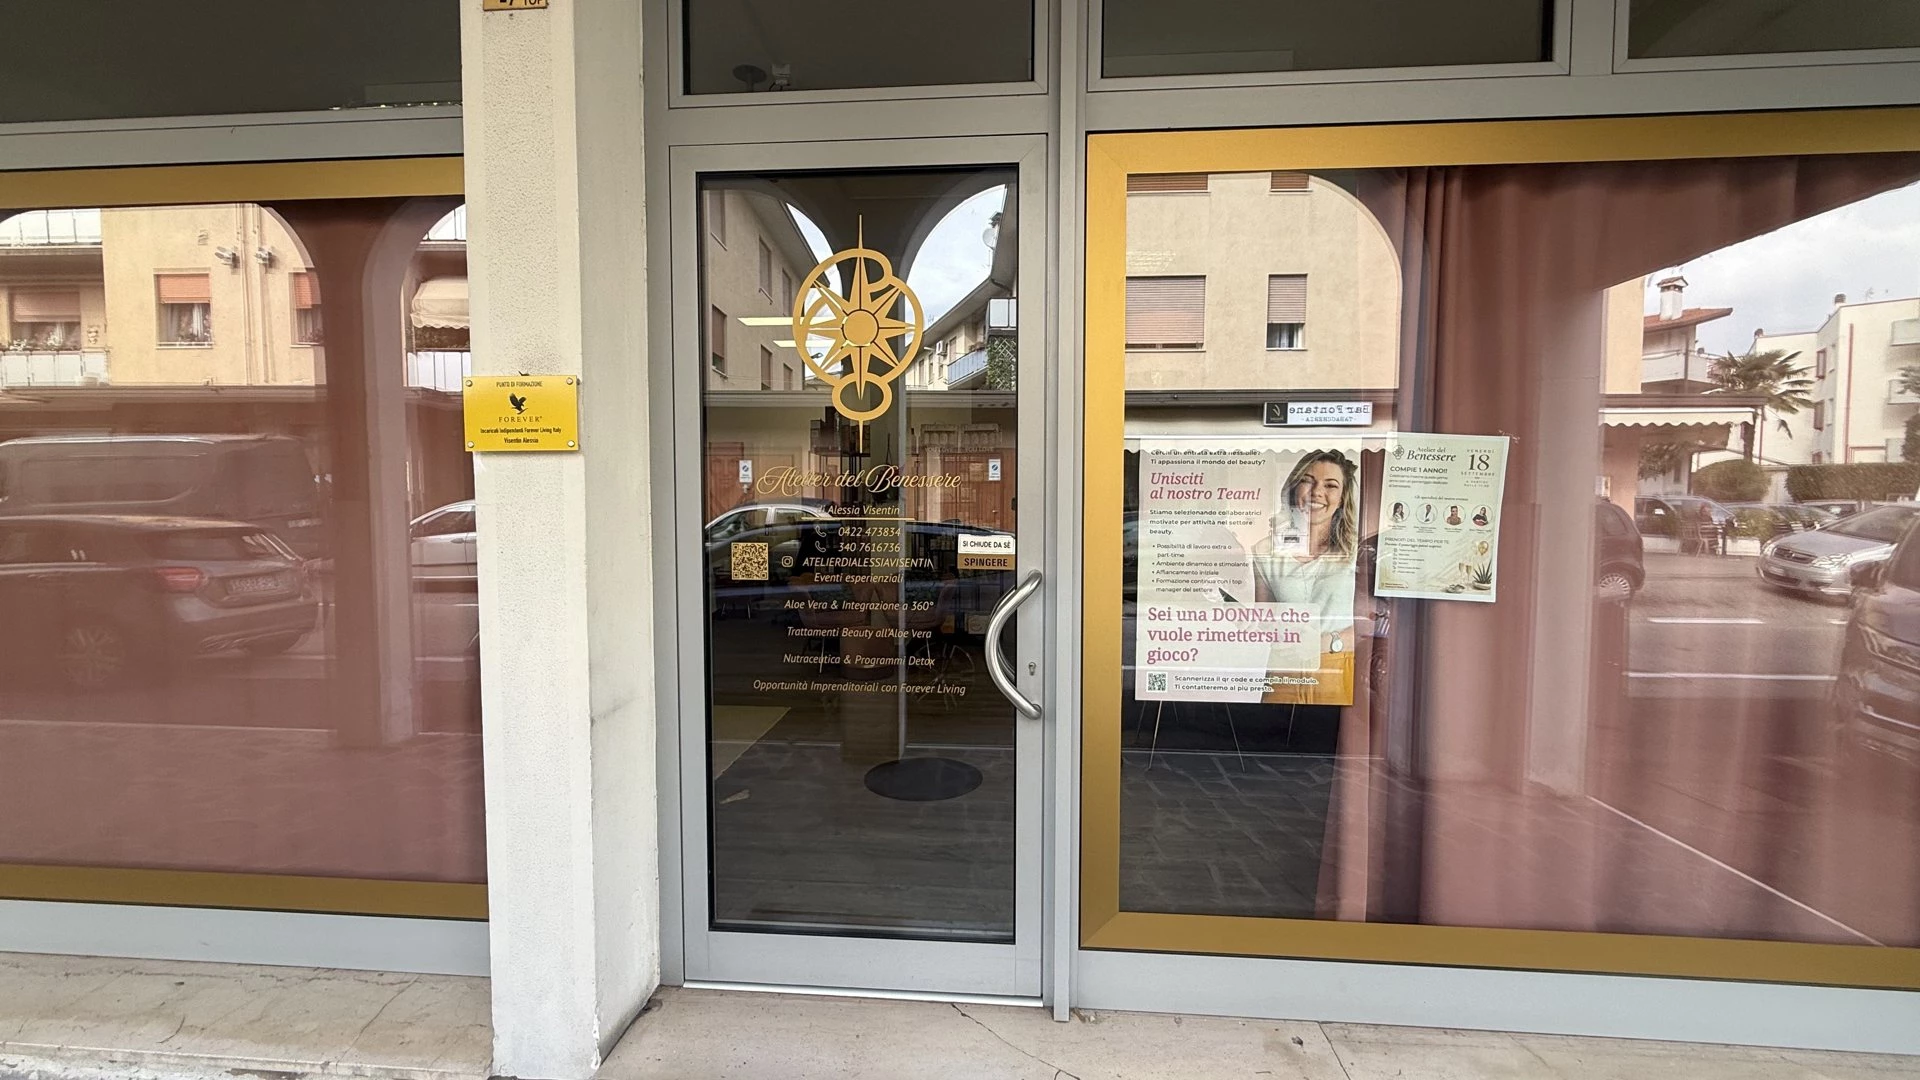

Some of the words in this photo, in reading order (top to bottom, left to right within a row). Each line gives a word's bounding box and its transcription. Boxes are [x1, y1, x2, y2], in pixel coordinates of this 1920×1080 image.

[1407, 450, 1456, 462] Benessere
[1468, 454, 1490, 471] 18
[756, 465, 832, 496] Atelier
[834, 469, 864, 488] del
[865, 464, 962, 493] Benessere
[1150, 472, 1204, 485] Unisciti
[1150, 487, 1163, 499] al
[1167, 488, 1212, 500] nostro
[1217, 488, 1261, 500] Team!
[828, 505, 860, 515] Alessia
[863, 505, 900, 515] Visentin
[838, 527, 861, 537] 0422
[865, 527, 900, 537] 473834
[838, 542, 856, 552] 340
[860, 542, 900, 552] 7616736
[964, 558, 1008, 567] SPINGERE
[814, 572, 843, 582] Eventi
[845, 573, 904, 584] esperienziali
[784, 600, 804, 609] Aloe
[807, 600, 827, 610] Vera
[831, 600, 838, 610] &
[842, 600, 900, 612] Integrazione
[911, 601, 934, 611] 360°
[1148, 607, 1171, 621] Sei
[1176, 610, 1207, 621] una
[1212, 608, 1276, 622] DONNA
[1281, 608, 1310, 623] che
[787, 626, 840, 637] Trattamenti
[841, 627, 874, 640] Beauty
[912, 629, 932, 638] Vera
[1147, 627, 1193, 642] vuole
[1196, 628, 1279, 642] rimettersi
[1282, 628, 1301, 643] in
[783, 654, 840, 664] Nutraceutica
[844, 654, 851, 665] &
[855, 655, 906, 668] Programmi
[908, 656, 935, 666] Detox
[1147, 647, 1199, 665] gioco?
[753, 679, 808, 691] Opportunità
[810, 681, 879, 694] Imprenditoriali
[881, 684, 898, 692] con
[900, 683, 935, 693] Forever
[937, 684, 966, 695] Living
